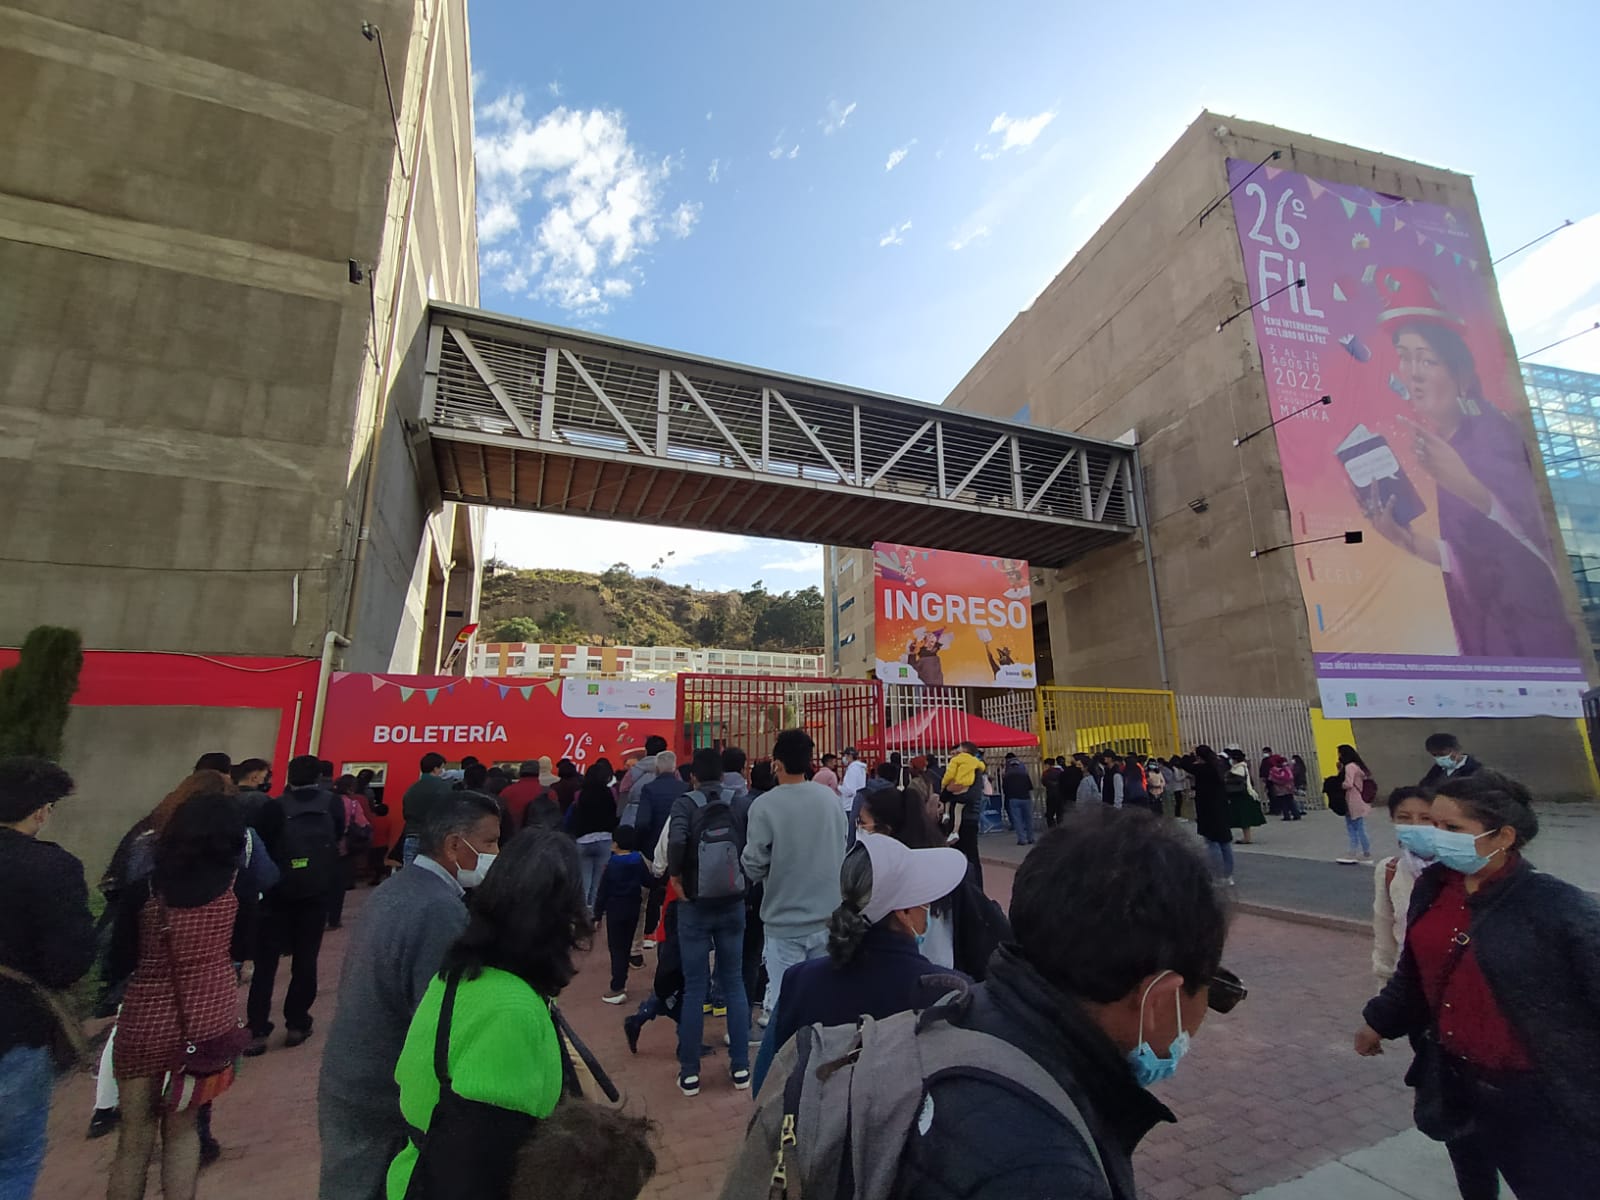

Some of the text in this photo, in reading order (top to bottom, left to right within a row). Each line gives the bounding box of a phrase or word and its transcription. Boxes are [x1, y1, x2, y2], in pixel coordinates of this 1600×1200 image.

[1245, 182, 1307, 250] 26º
[1258, 250, 1325, 319] FIL
[1272, 356, 1320, 372] AGOSTO
[1284, 348, 1297, 359] AL
[1274, 367, 1323, 392] 2022
[884, 588, 1027, 629] INGRESO
[373, 721, 508, 743] BOLETERÍA
